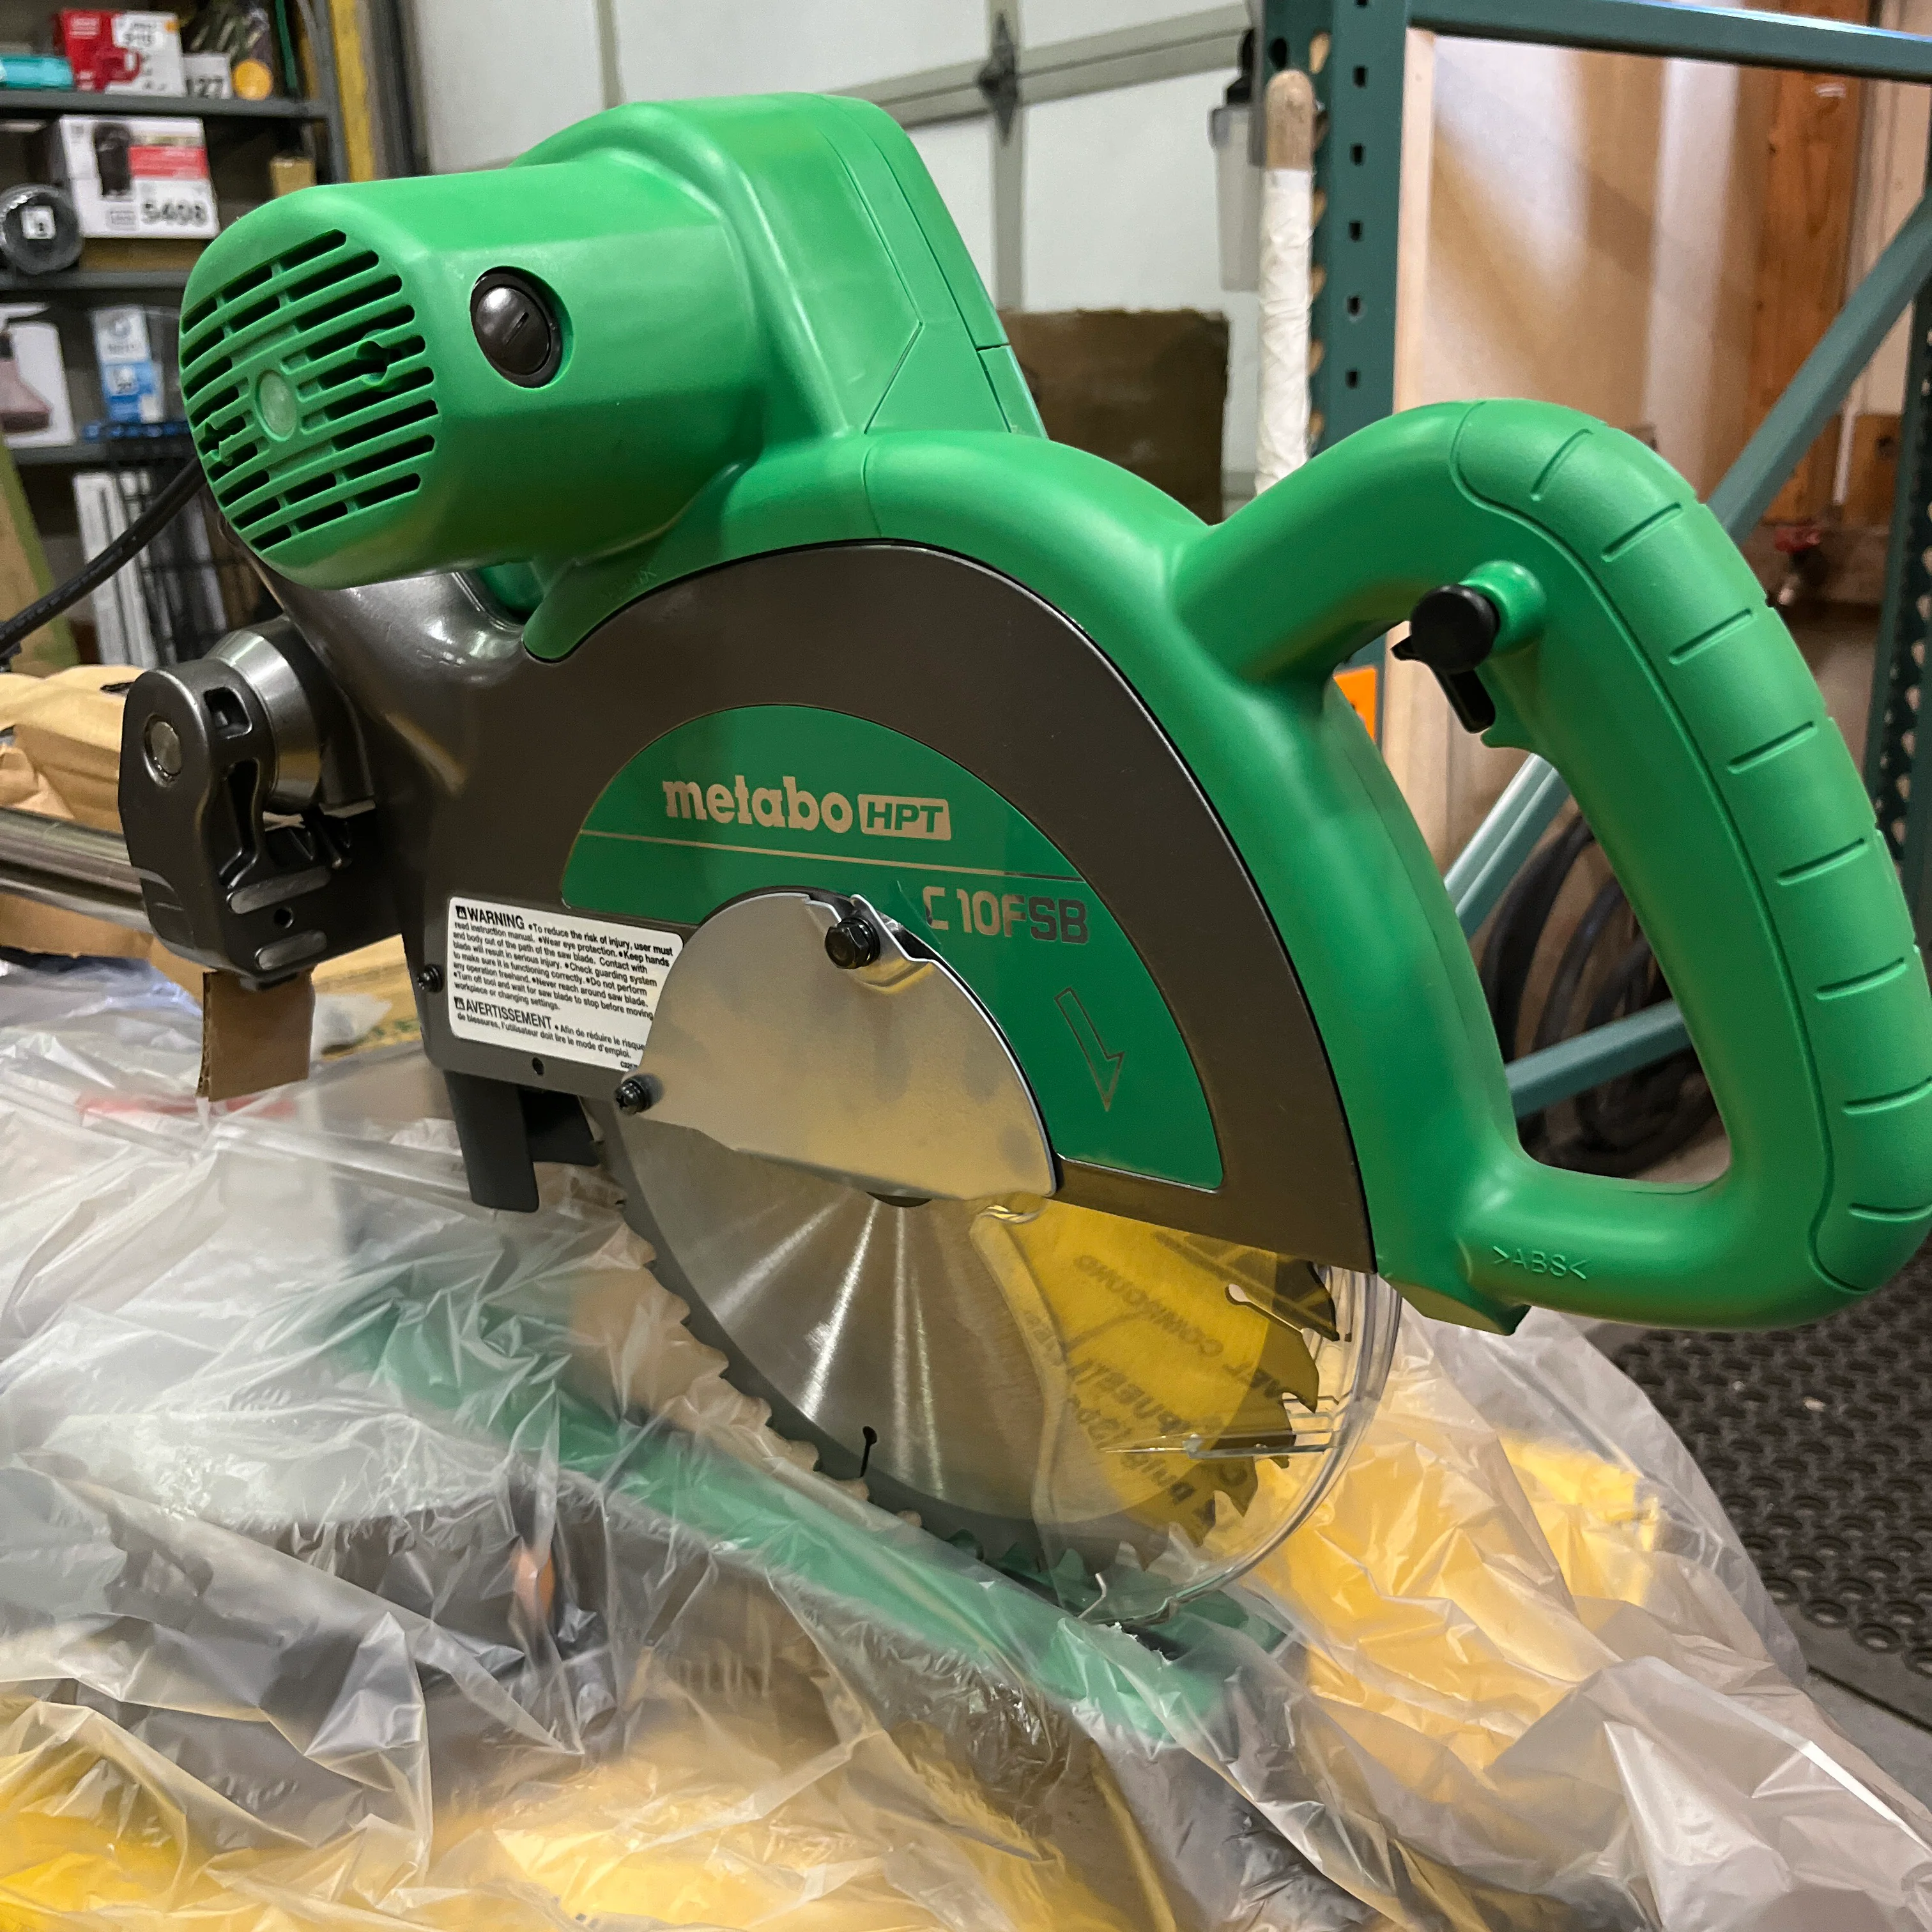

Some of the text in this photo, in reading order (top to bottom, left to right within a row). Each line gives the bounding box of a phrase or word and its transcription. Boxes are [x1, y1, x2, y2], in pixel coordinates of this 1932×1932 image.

[663, 776, 946, 834] metabo HPT
[453, 931, 648, 974] and body out of the path of the saw blade. Contact with
[454, 921, 670, 967] read instruction manual. Wear eye protection. Keep hands
[467, 907, 673, 956] WARNING To reduce the risk of injury, user must
[453, 940, 471, 951] blade
[486, 947, 505, 958] result
[505, 949, 512, 958] in
[514, 953, 539, 965] serious
[540, 957, 563, 970] injury.
[569, 962, 593, 975] Check
[595, 968, 628, 983] guarding
[629, 974, 657, 987] system
[453, 951, 461, 960] to
[462, 953, 480, 963] make
[482, 958, 496, 967] sure
[511, 961, 549, 978] functioning
[551, 969, 585, 985] correctly.
[590, 977, 601, 987] Do
[603, 980, 615, 990] not
[617, 983, 647, 996] perform
[453, 962, 464, 972] any
[466, 964, 498, 976] operation
[536, 977, 556, 988] Never
[558, 981, 579, 993] reach
[581, 986, 606, 999] around
[608, 992, 623, 1002] saw
[624, 994, 648, 1008] blade.
[454, 981, 487, 995] workpiece
[498, 990, 529, 1006] changing
[457, 971, 473, 981] Turn
[483, 976, 496, 986] tool
[498, 981, 510, 990] and
[526, 985, 536, 994] for
[538, 989, 552, 998] saw
[553, 990, 573, 1002] blade
[574, 995, 582, 1004] to
[584, 997, 599, 1009] stop
[601, 1000, 624, 1013] before
[626, 1006, 654, 1021] moving
[457, 1012, 466, 1020] de
[540, 1030, 553, 1041] doit
[555, 1032, 566, 1043] lire
[567, 1036, 574, 1045] le
[576, 1039, 596, 1051] mode
[466, 998, 645, 1052] AVERTISSEMENT Afin de réduire le risque
